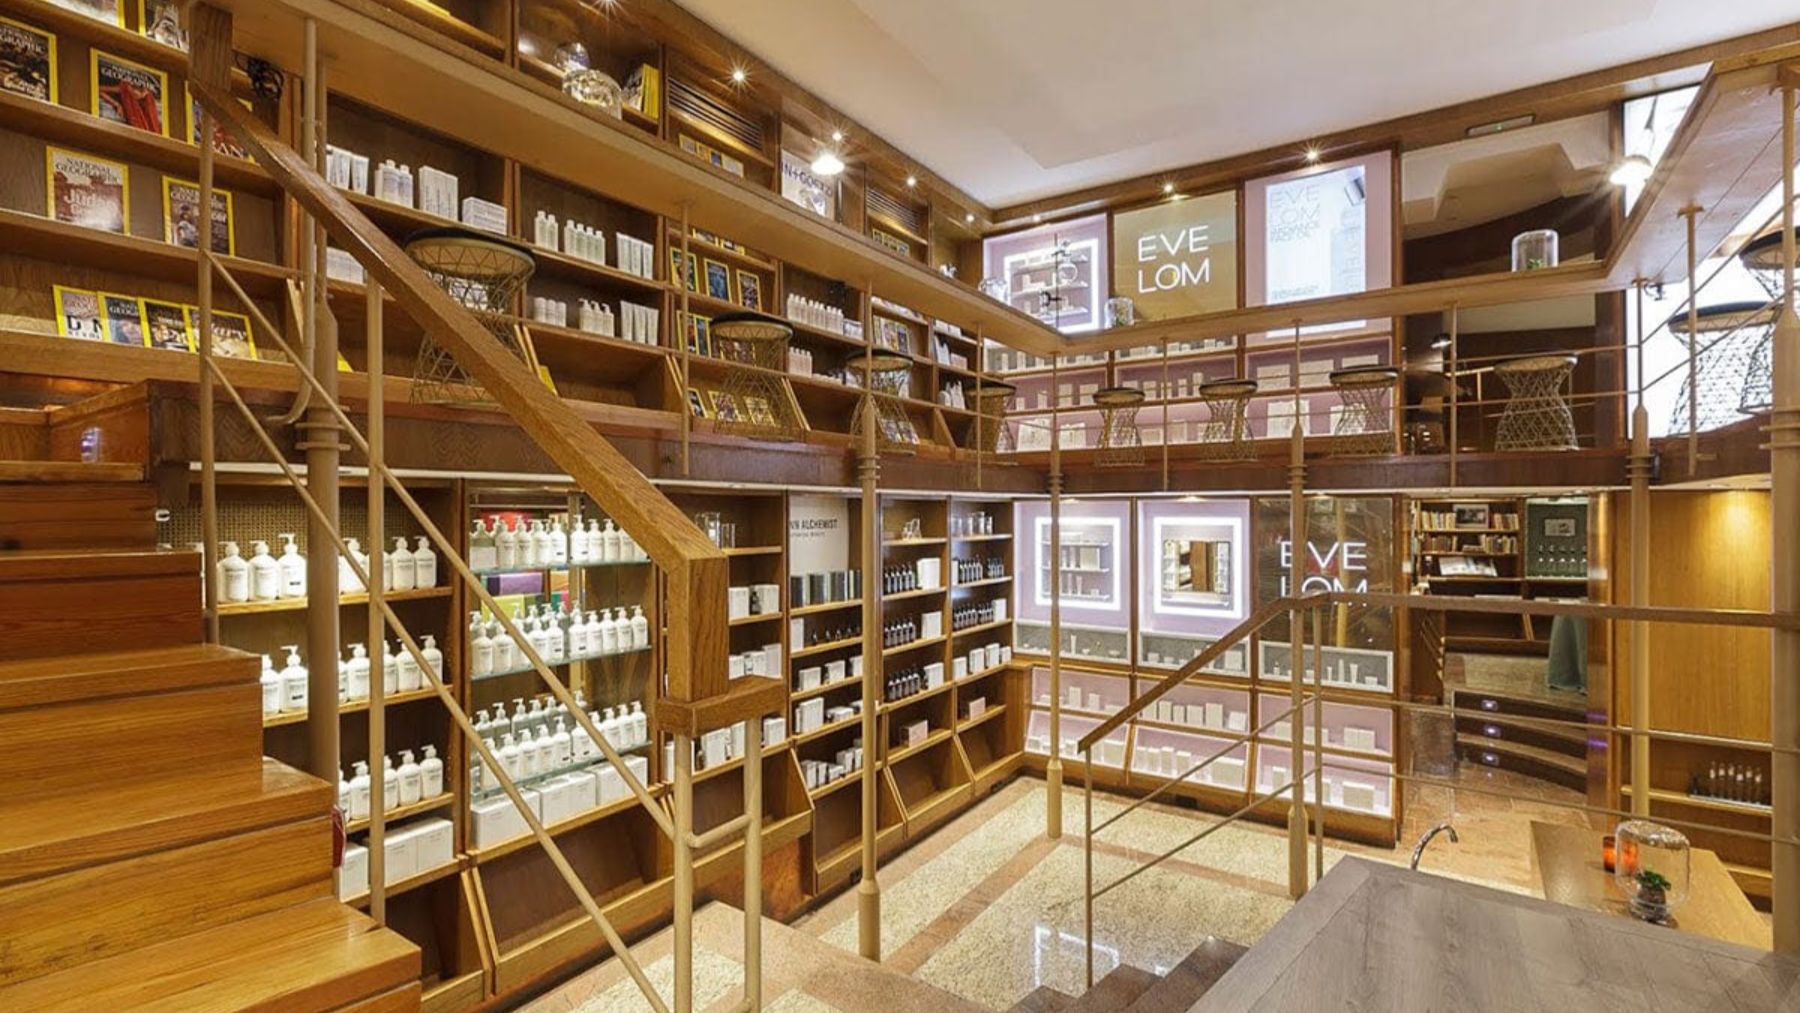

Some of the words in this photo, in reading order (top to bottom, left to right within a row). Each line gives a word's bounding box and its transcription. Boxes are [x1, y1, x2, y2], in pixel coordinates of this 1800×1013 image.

[1138, 225, 1208, 262] EVE
[1138, 257, 1210, 293] LOM
[1281, 541, 1367, 570] EVE
